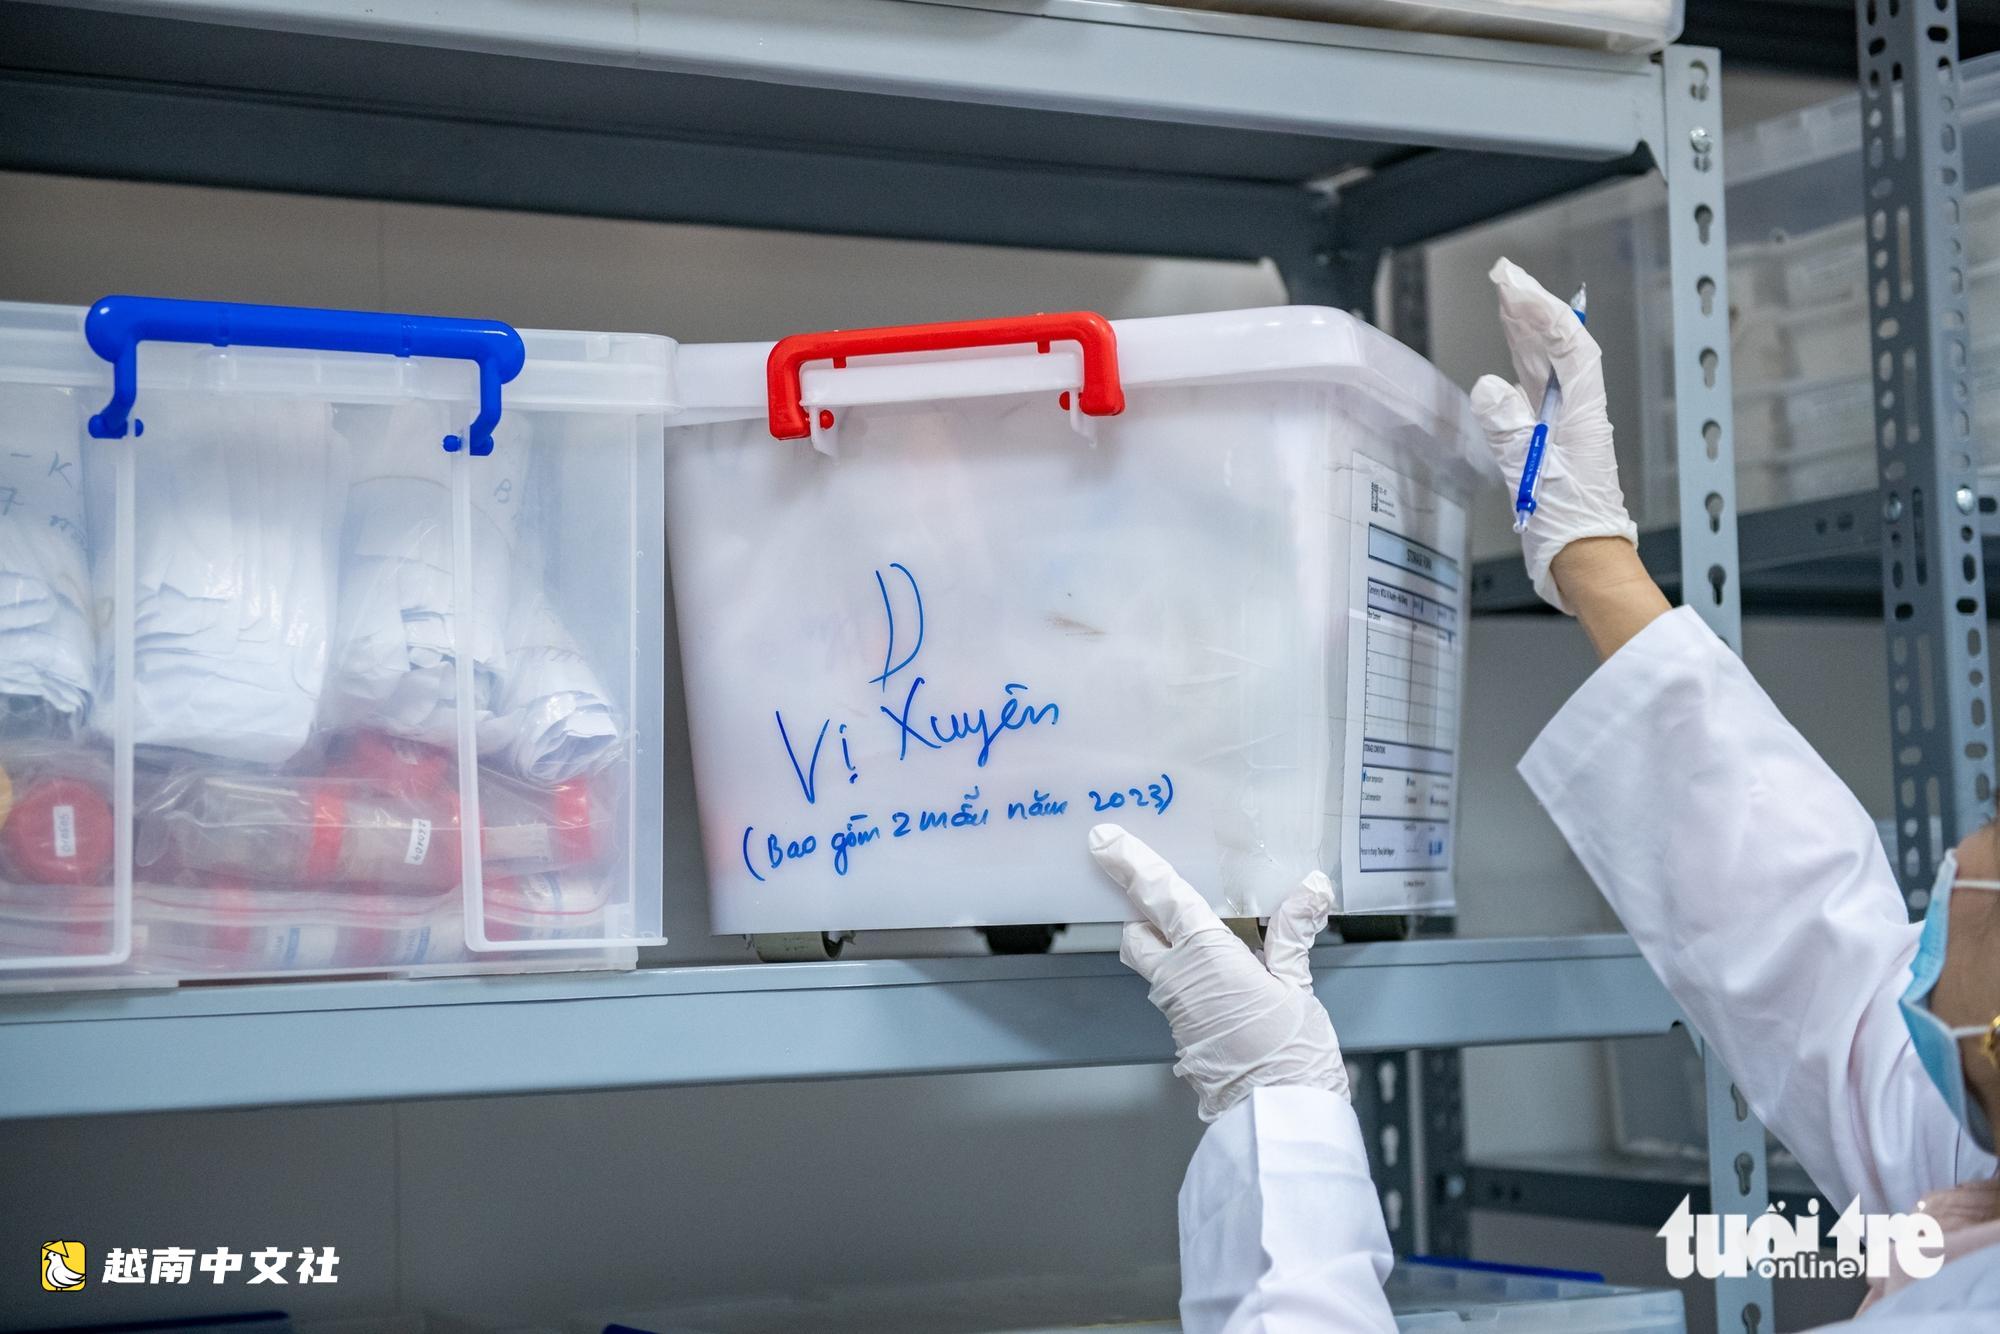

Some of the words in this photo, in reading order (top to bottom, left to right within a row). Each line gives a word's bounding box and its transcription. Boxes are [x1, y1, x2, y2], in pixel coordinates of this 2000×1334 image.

[776, 711, 859, 804] Vị
[880, 677, 1060, 768] Xuyên
[892, 811, 912, 838] 2
[1008, 789, 1068, 820] năm
[1088, 773, 1174, 815] 2023)
